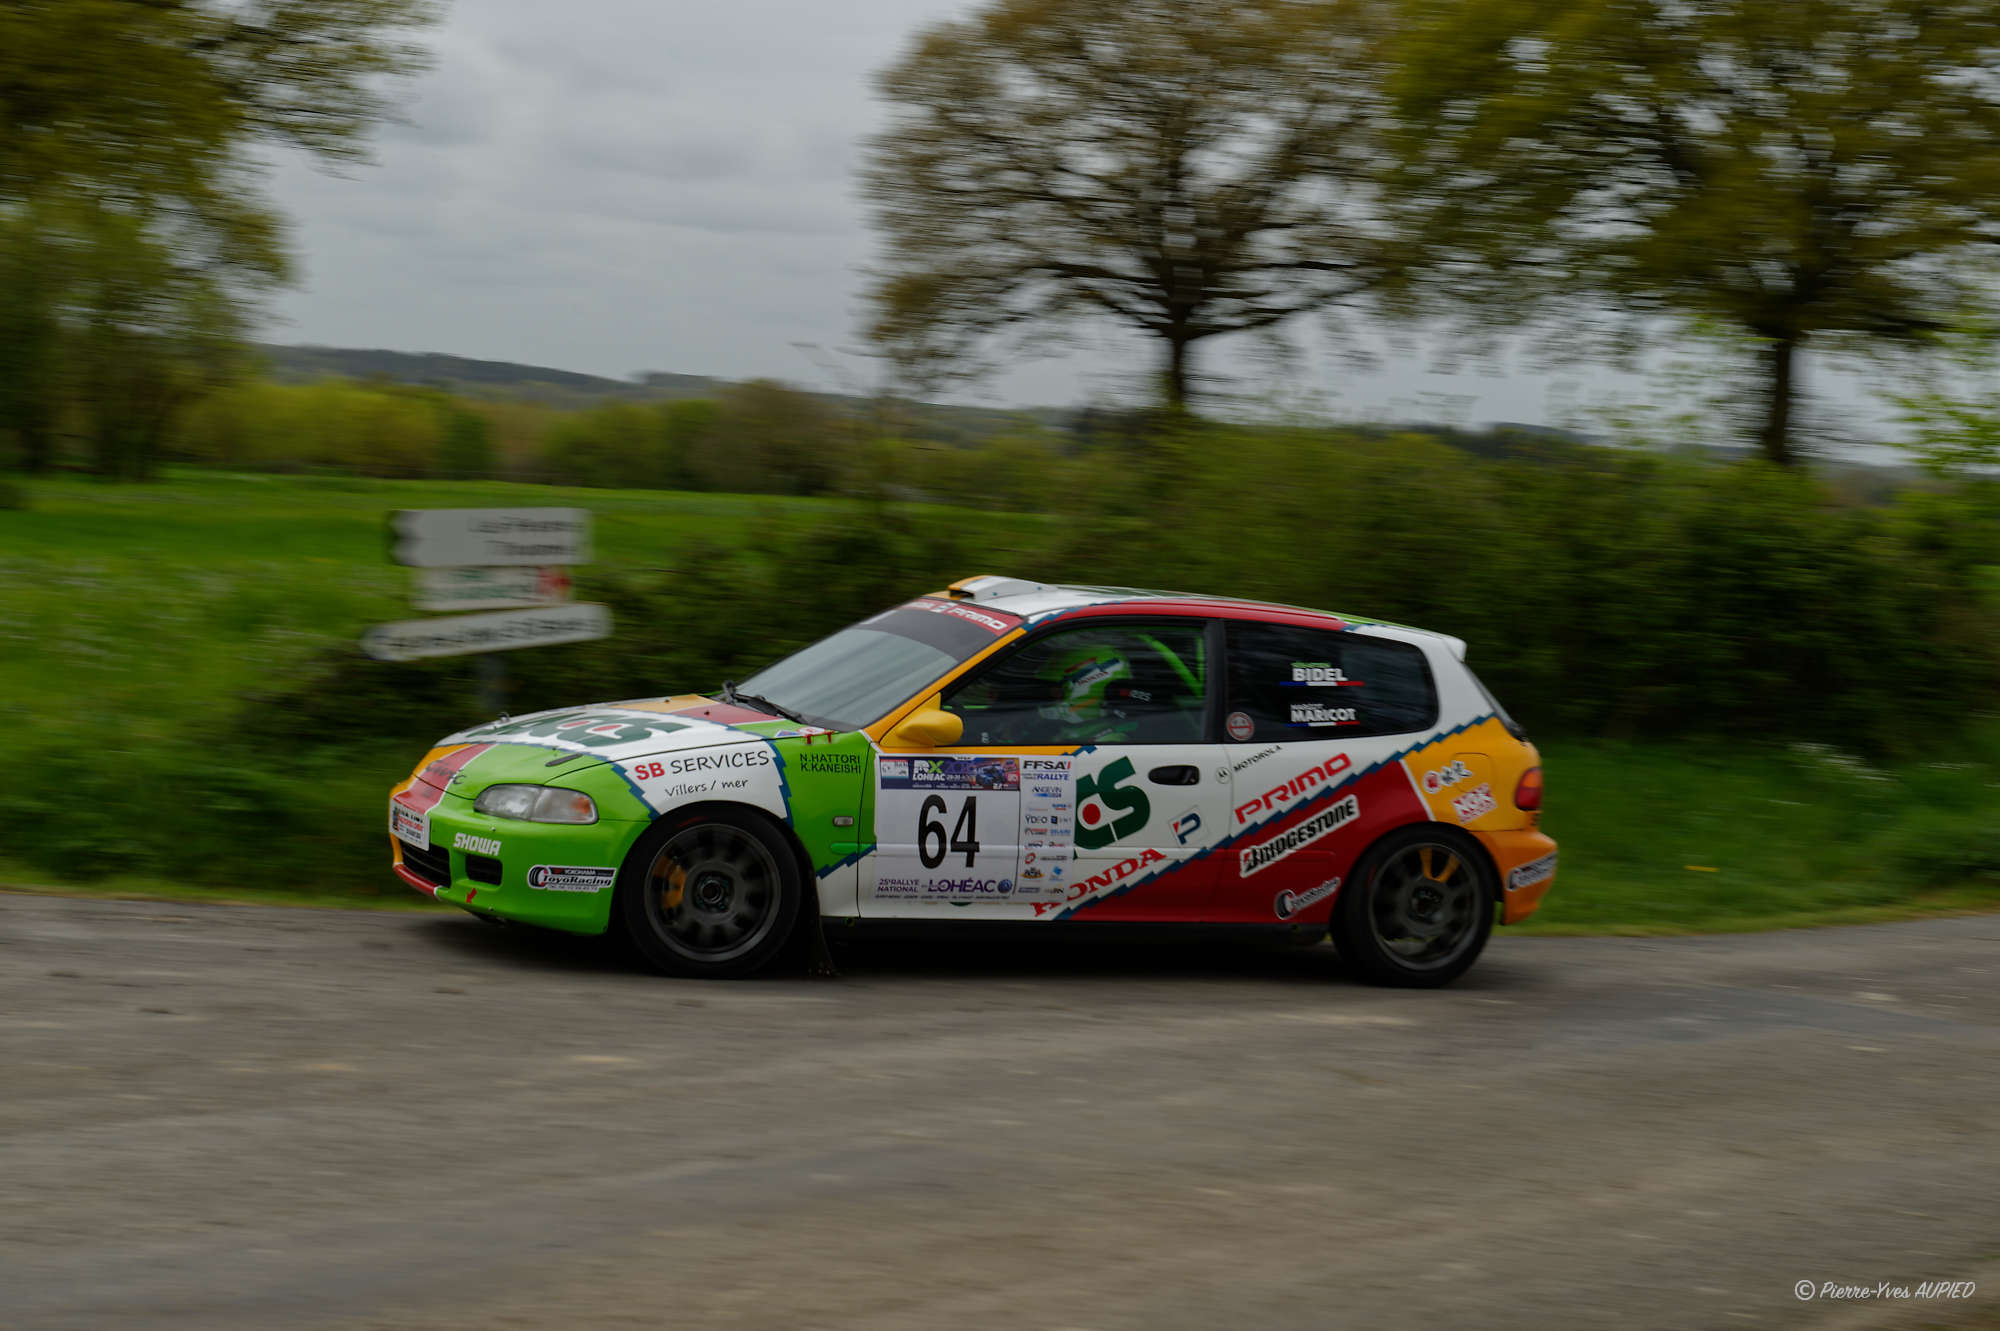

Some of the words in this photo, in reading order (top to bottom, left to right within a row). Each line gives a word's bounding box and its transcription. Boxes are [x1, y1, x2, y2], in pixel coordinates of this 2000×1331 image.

[1292, 667, 1349, 681] BIDEL
[634, 762, 665, 781] SB
[670, 750, 770, 775] SERVICES
[665, 783, 707, 797] Villers
[721, 778, 749, 789] mer
[1234, 753, 1352, 825] PRIMO
[453, 832, 502, 857] SHOWA
[918, 794, 980, 869] 64
[1244, 799, 1355, 872] BRIDGESTONE
[928, 877, 996, 893] LOHÉAC
